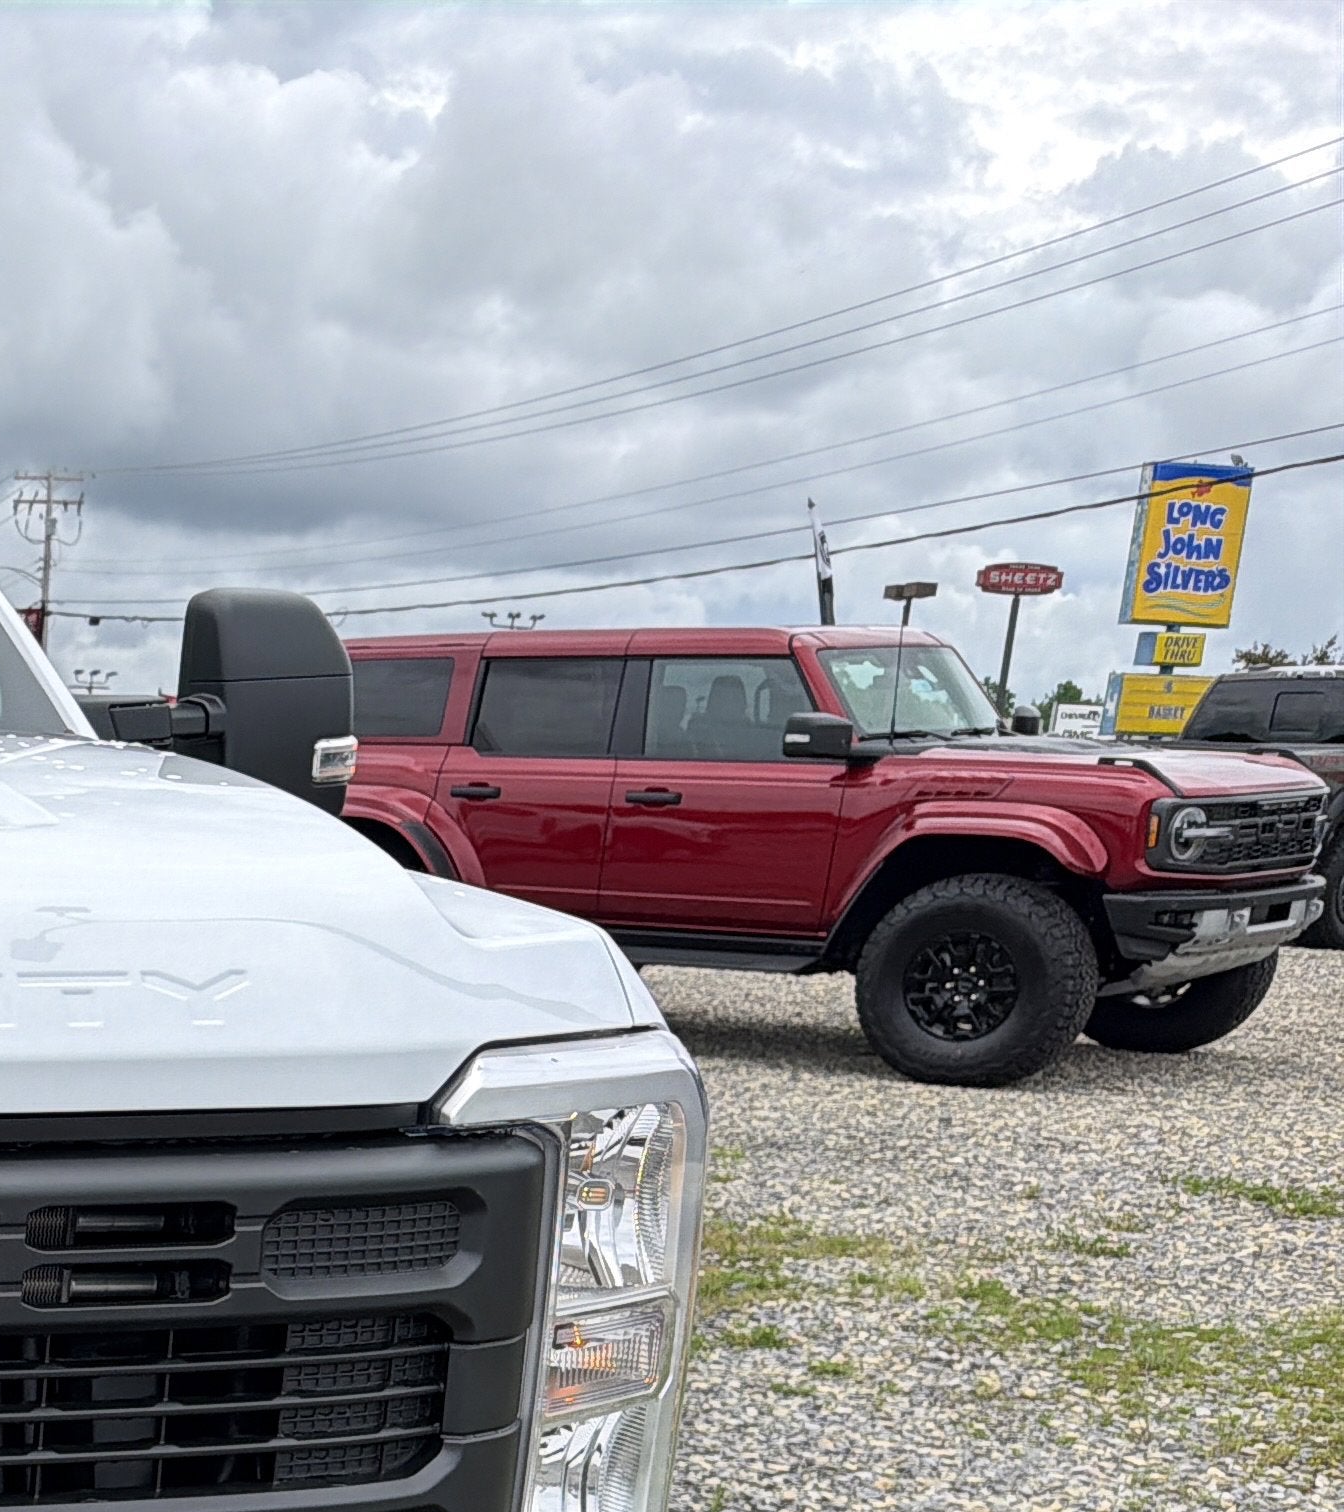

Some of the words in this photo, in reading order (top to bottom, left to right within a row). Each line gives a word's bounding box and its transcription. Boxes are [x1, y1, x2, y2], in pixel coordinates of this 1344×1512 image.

[1166, 500, 1228, 530] LONG
[989, 570, 1058, 586] SHEETZ
[1164, 636, 1200, 649] DRIVE
[1163, 649, 1196, 662] THRU
